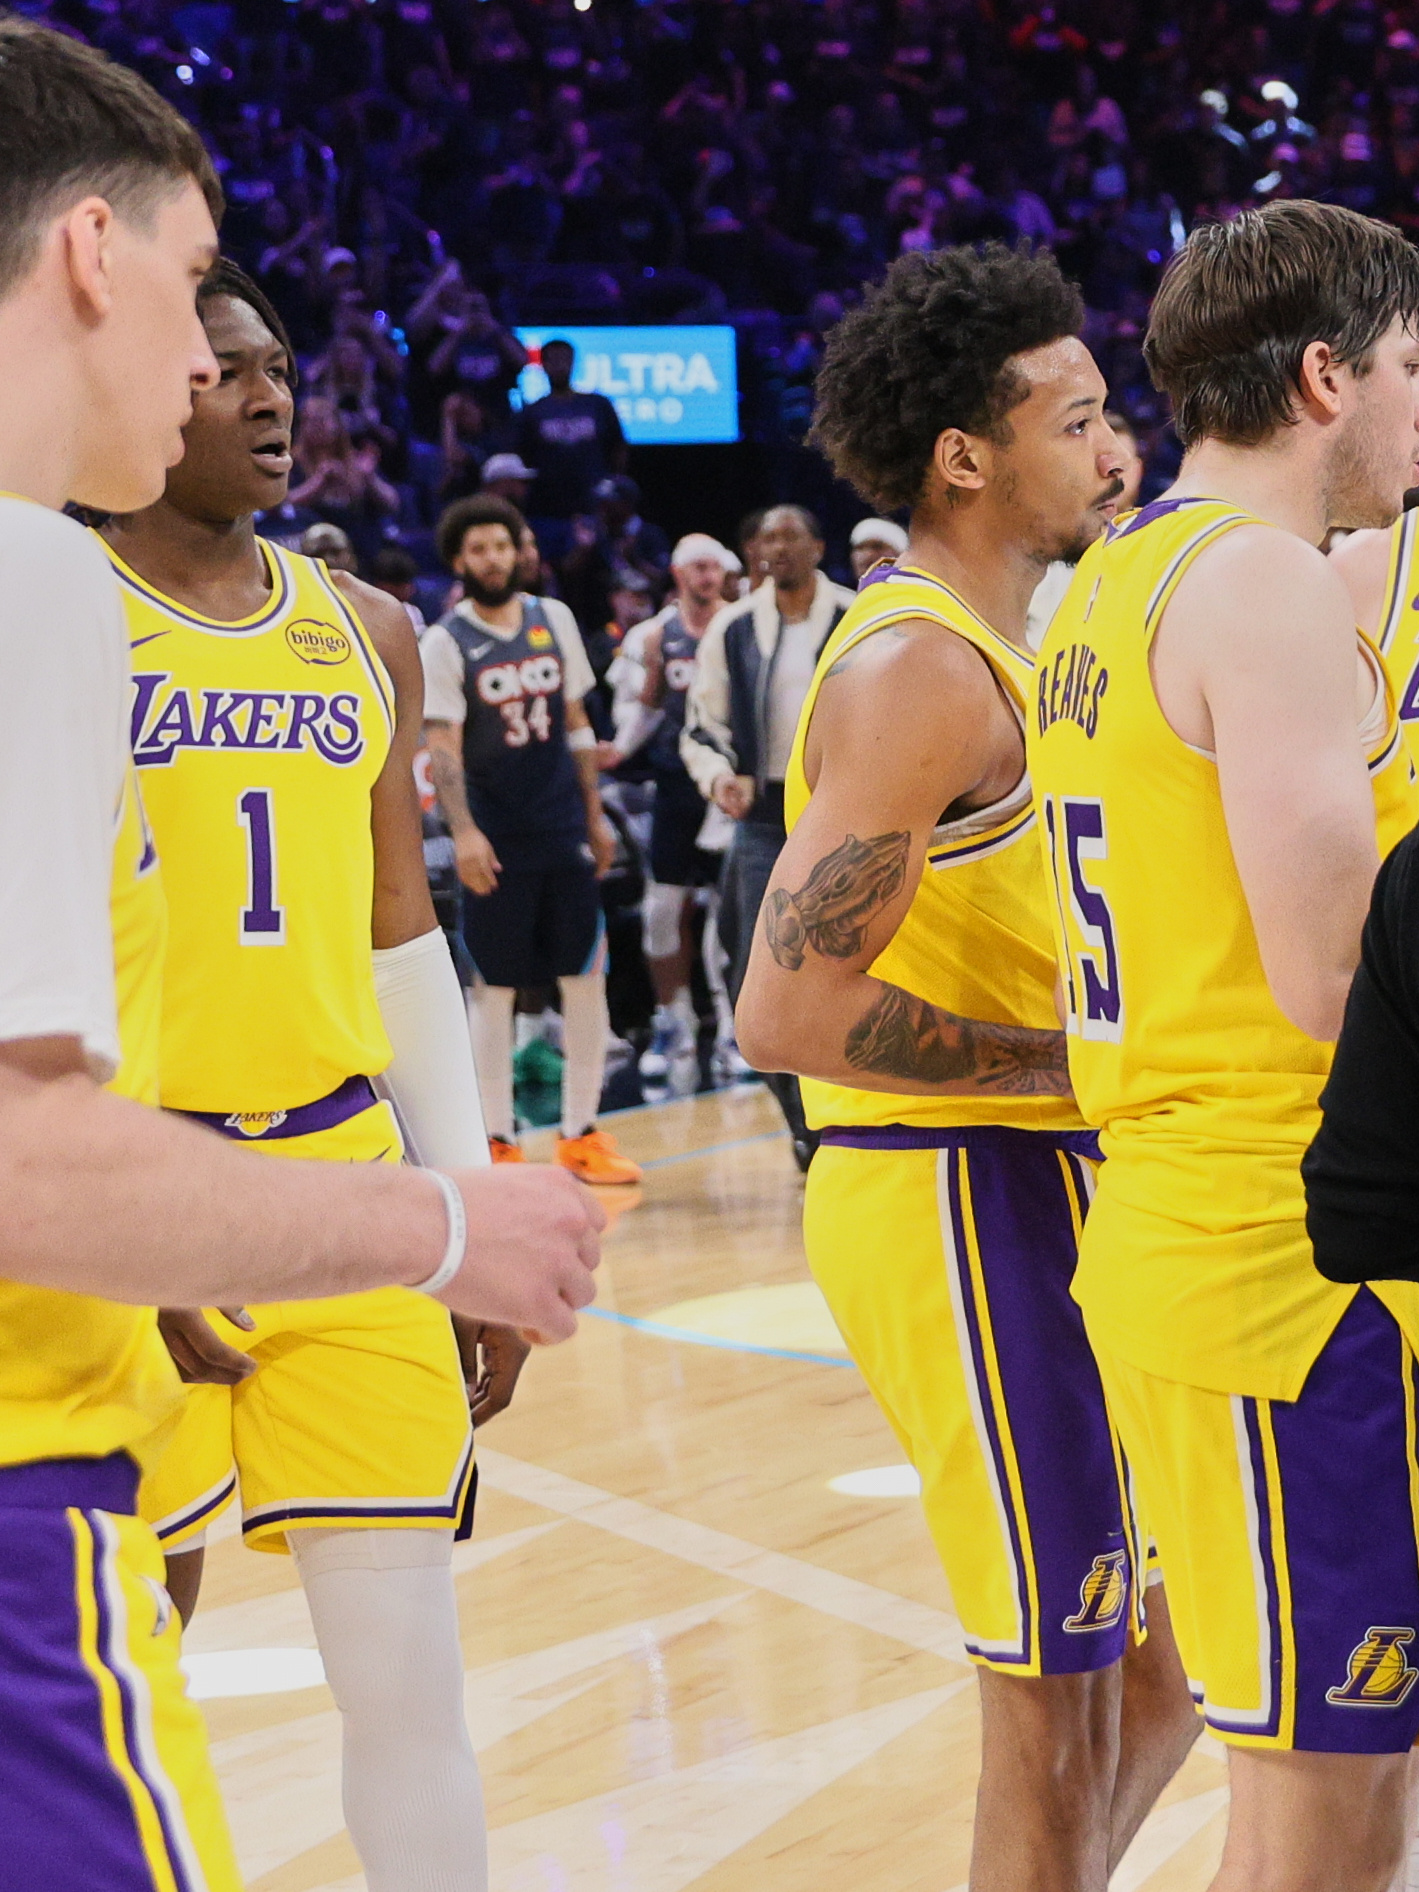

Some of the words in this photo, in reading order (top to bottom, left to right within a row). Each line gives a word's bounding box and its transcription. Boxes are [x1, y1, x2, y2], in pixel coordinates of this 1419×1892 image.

[290, 629, 346, 653] bibigo
[130, 673, 366, 766] LAKERS
[500, 696, 552, 748] 34
[1038, 643, 1109, 740] REAVES
[239, 789, 284, 943] 1
